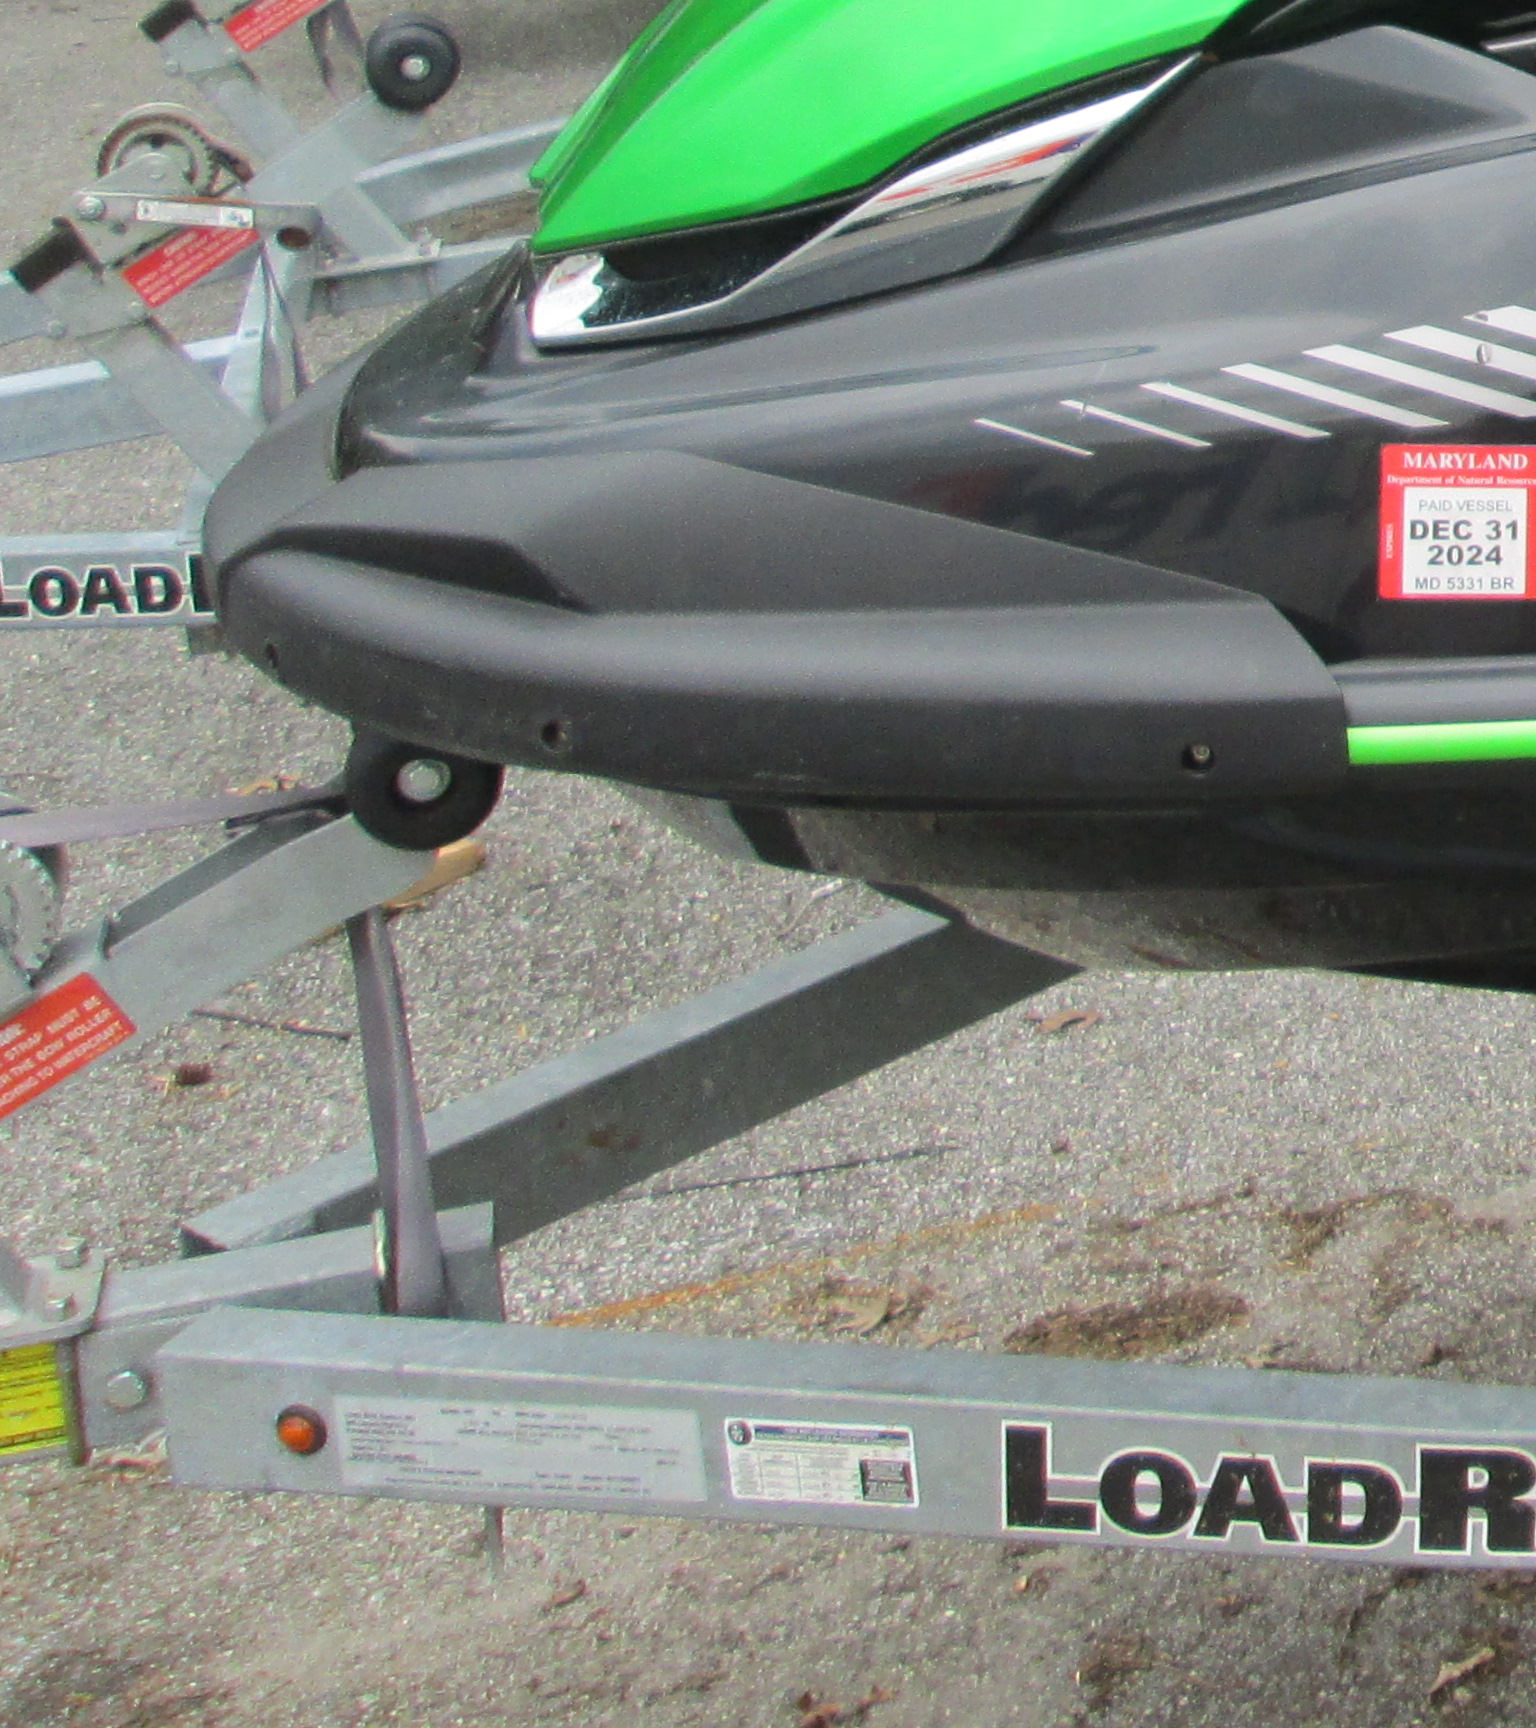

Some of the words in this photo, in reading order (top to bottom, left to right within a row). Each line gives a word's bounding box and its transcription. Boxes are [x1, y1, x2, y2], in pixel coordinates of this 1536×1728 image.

[1403, 452, 1529, 469] MARYLAND
[1387, 475, 1443, 486] Department
[1445, 475, 1455, 484] of
[1458, 475, 1494, 485] Natural
[1418, 499, 1453, 512] PAID
[1456, 499, 1513, 512] VESSEL
[1409, 519, 1473, 541] DEC
[1485, 519, 1519, 541] 31
[1427, 544, 1503, 566] 2024
[1414, 577, 1441, 590] MD
[1447, 577, 1483, 590] 5331
[1490, 577, 1515, 590] BR
[66, 1008, 113, 1042] ROLLER
